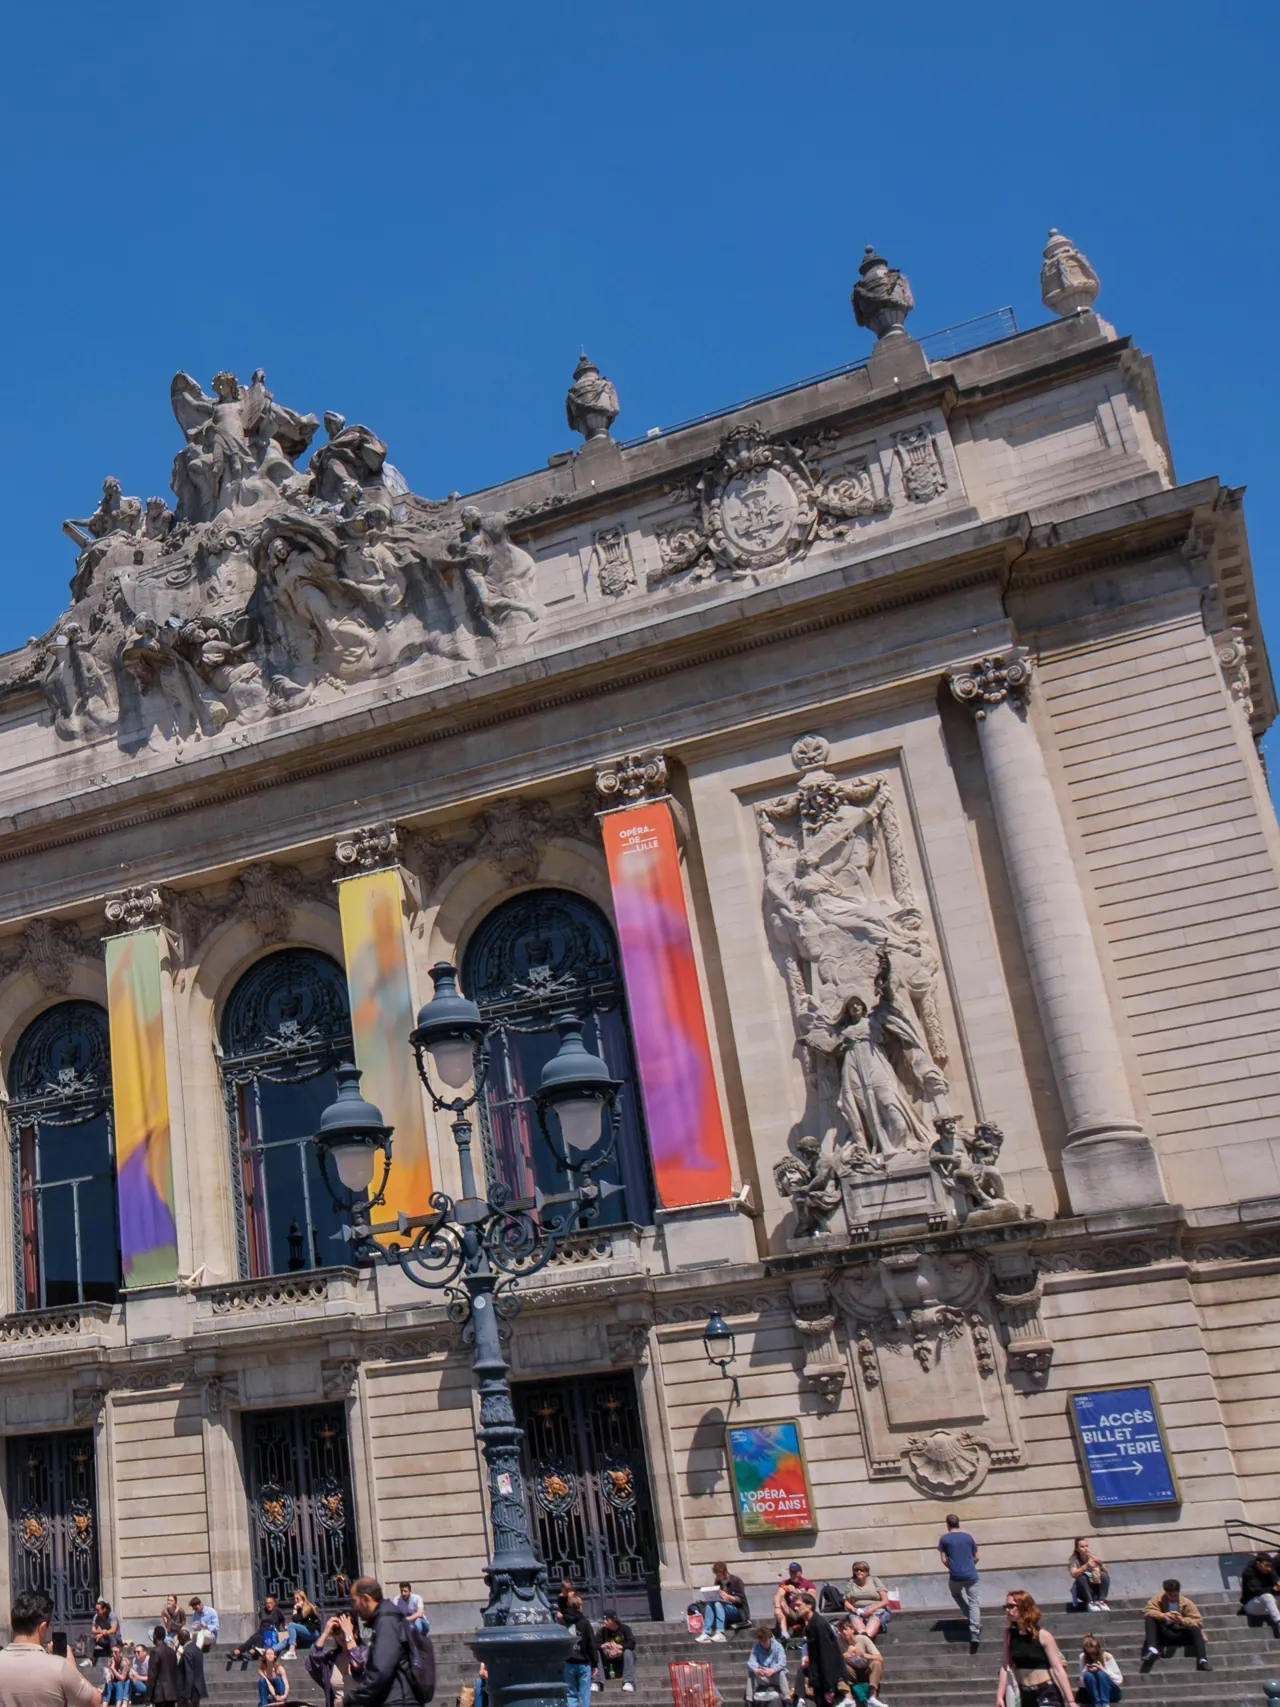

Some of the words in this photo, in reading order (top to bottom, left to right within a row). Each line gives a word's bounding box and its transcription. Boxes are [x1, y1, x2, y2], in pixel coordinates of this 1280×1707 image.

[619, 826, 649, 839] OPÉRA
[629, 837, 641, 845] DE
[637, 840, 659, 852] LILLE
[1100, 1409, 1154, 1427] ACCÈS
[1082, 1428, 1132, 1444] BILLET
[1117, 1441, 1161, 1455] TERIE
[740, 1488, 786, 1501] L'OPÉRA
[743, 1503, 750, 1513] A
[752, 1502, 775, 1512] 100
